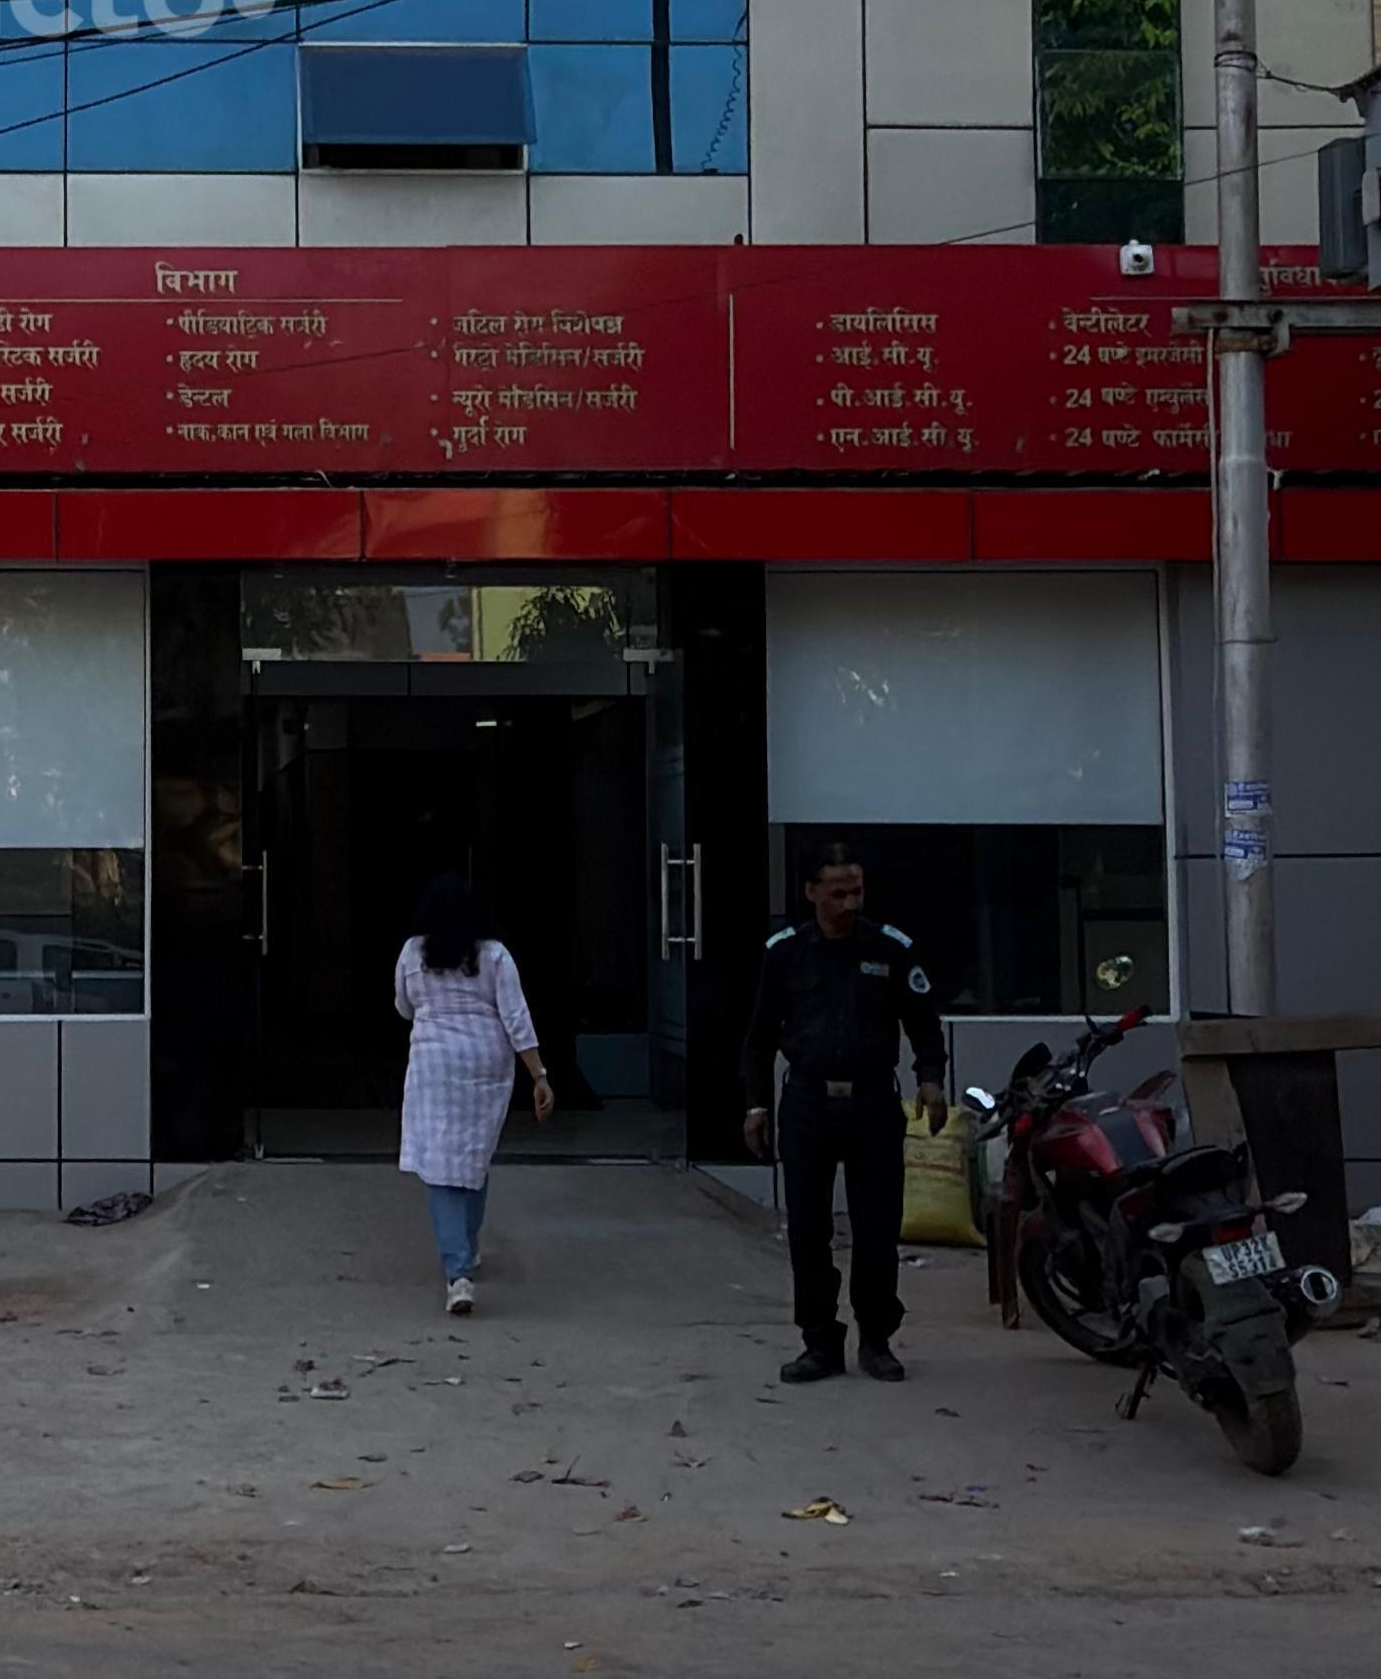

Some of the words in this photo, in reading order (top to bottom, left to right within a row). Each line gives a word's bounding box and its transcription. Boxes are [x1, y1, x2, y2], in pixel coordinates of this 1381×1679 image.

[155, 261, 238, 294] विभाग
[19, 307, 53, 334] रोग
[48, 340, 100, 369] सर्जरी
[226, 344, 259, 372] रोग
[1063, 344, 1092, 365] 24
[0, 377, 53, 407] सर्जरी
[1065, 388, 1092, 408] 24
[11, 416, 63, 446] सर्जरी
[494, 421, 527, 448] रोग
[1065, 427, 1093, 448] 24
